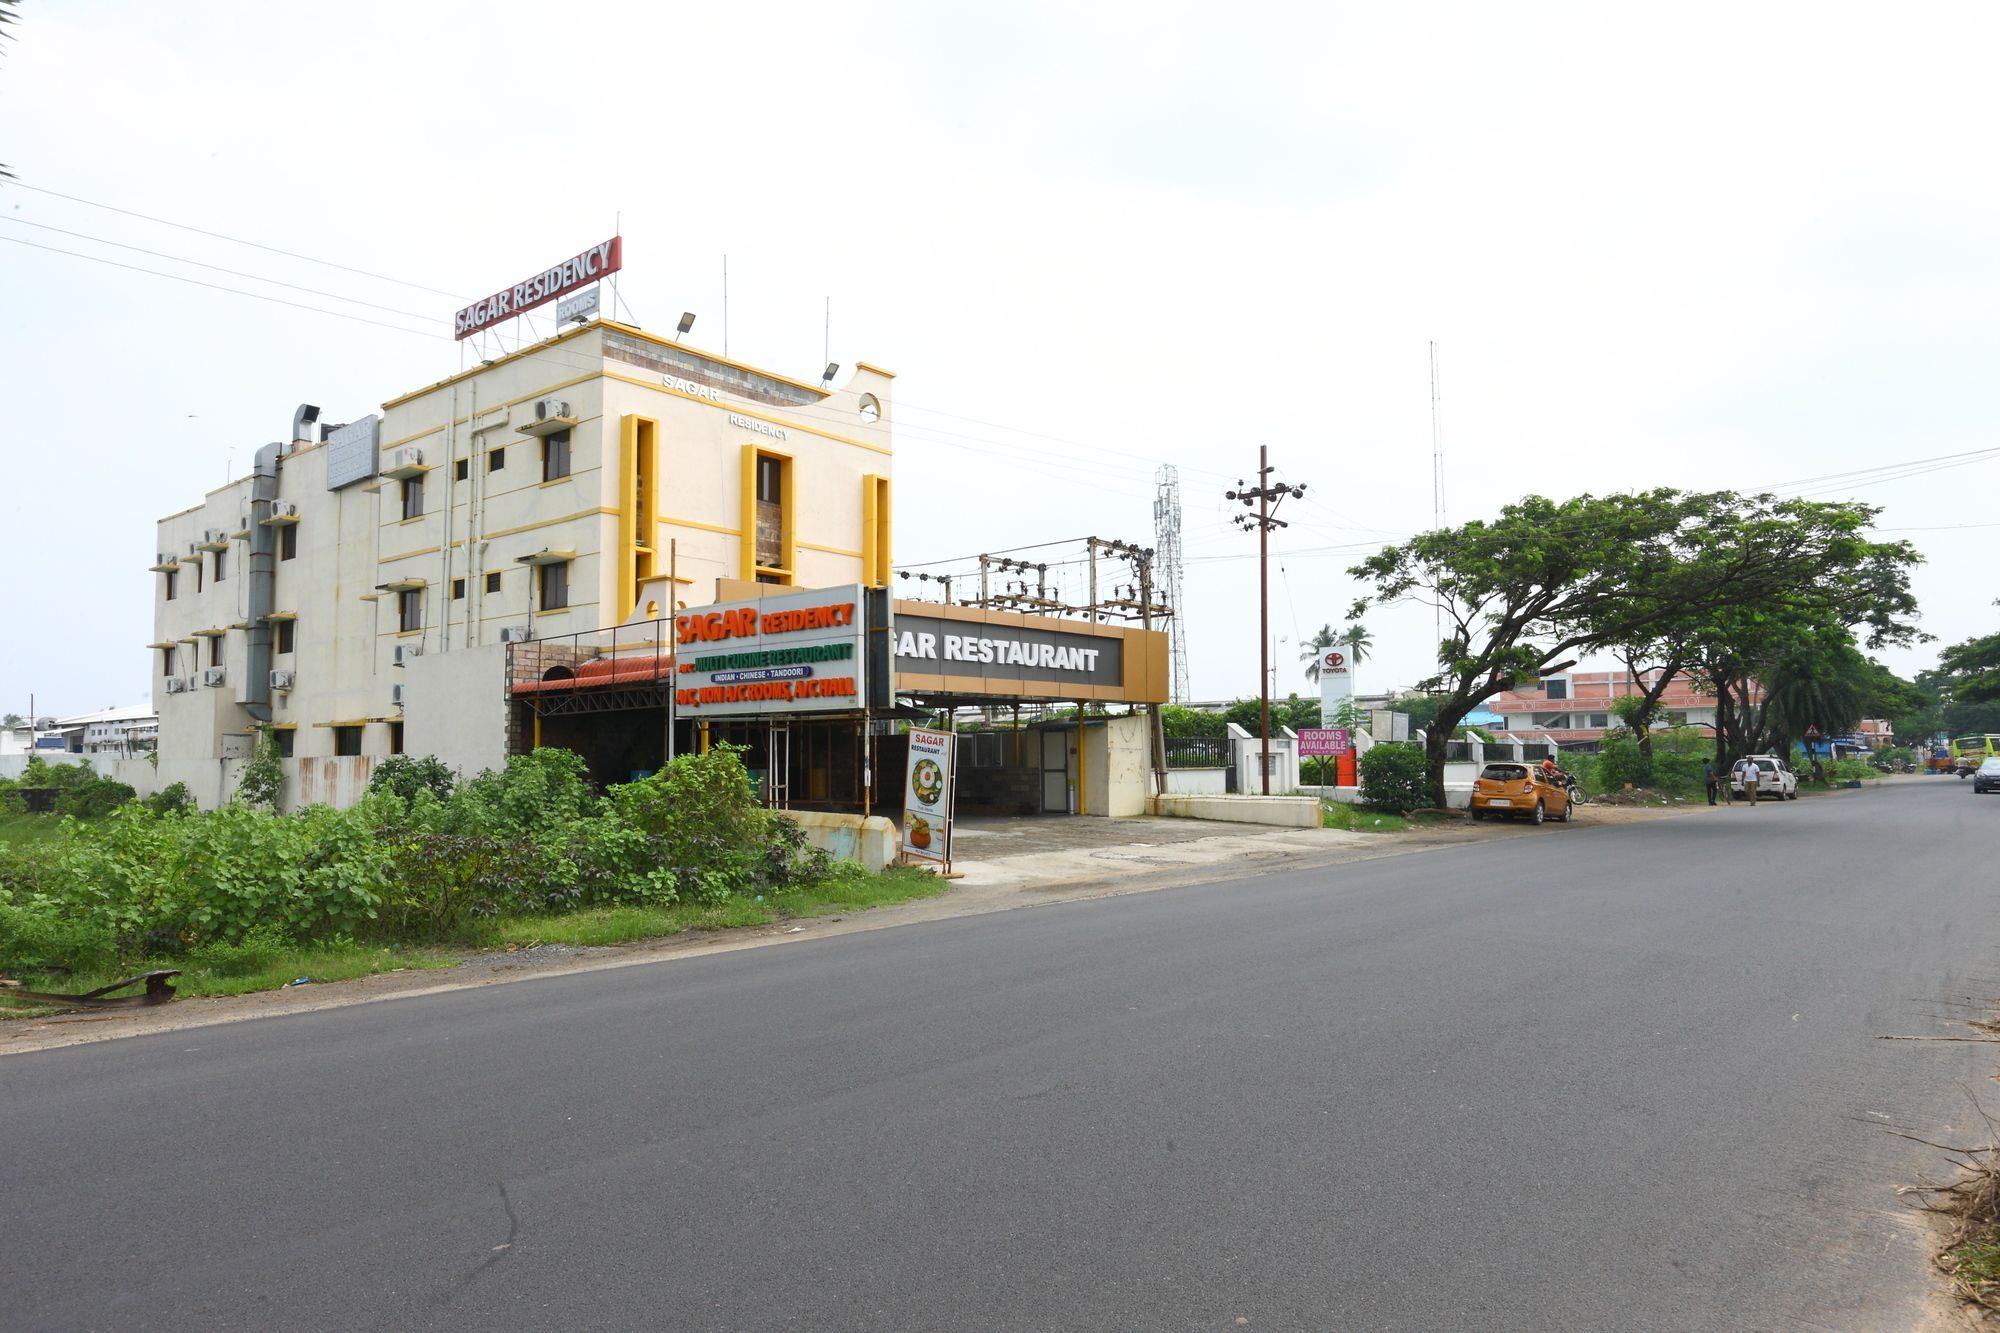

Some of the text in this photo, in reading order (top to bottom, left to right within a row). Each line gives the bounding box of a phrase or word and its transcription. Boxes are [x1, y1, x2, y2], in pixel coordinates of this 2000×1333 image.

[456, 240, 612, 335] SAGAR RESIDENCY
[558, 293, 597, 318] ROOMS
[662, 374, 721, 402] SAGAR
[729, 413, 790, 440] RESIDENCY
[676, 603, 855, 645] SAGAR RESIDENCY
[695, 655, 727, 672] MULTI
[727, 651, 768, 669] CUISINE
[768, 643, 853, 666] RESTAURANT
[943, 634, 1099, 672] RESTAURANT
[714, 668, 804, 682] INDIAN CHINESE TANDOORI
[699, 686, 725, 704] NON
[820, 677, 856, 697] HALL
[911, 742, 940, 755] RESTAURANT
[915, 734, 944, 747] SAGAR
[1300, 740, 1346, 750] AVAILABLE
[1303, 731, 1342, 740] ROOMS
